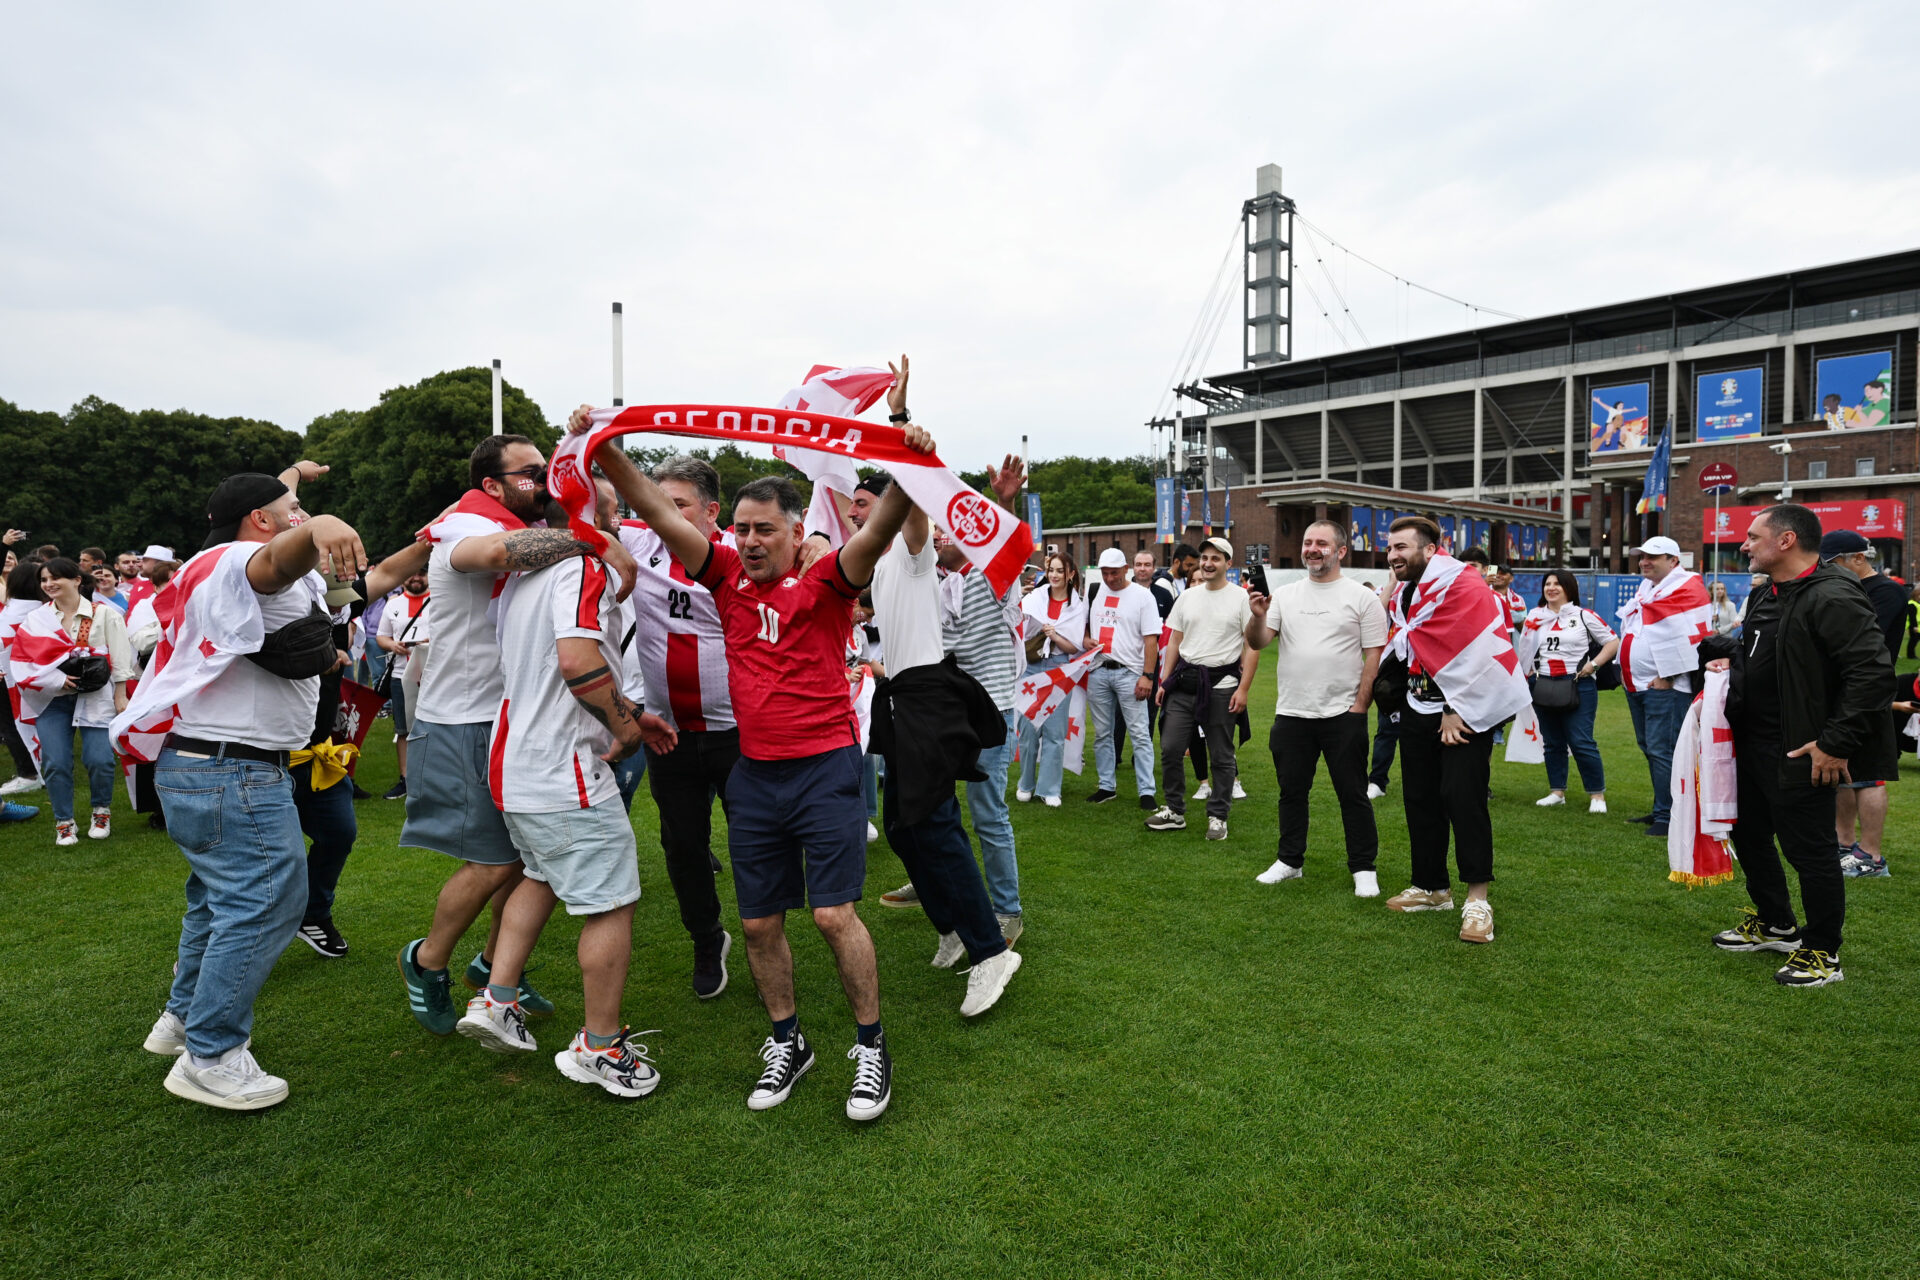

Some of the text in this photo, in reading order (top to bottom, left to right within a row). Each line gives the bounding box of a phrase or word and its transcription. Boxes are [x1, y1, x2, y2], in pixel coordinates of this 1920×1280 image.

[668, 588, 694, 620] 22
[757, 602, 780, 644] 10
[1546, 636, 1560, 652] 22
[1749, 629, 1761, 658] 7
